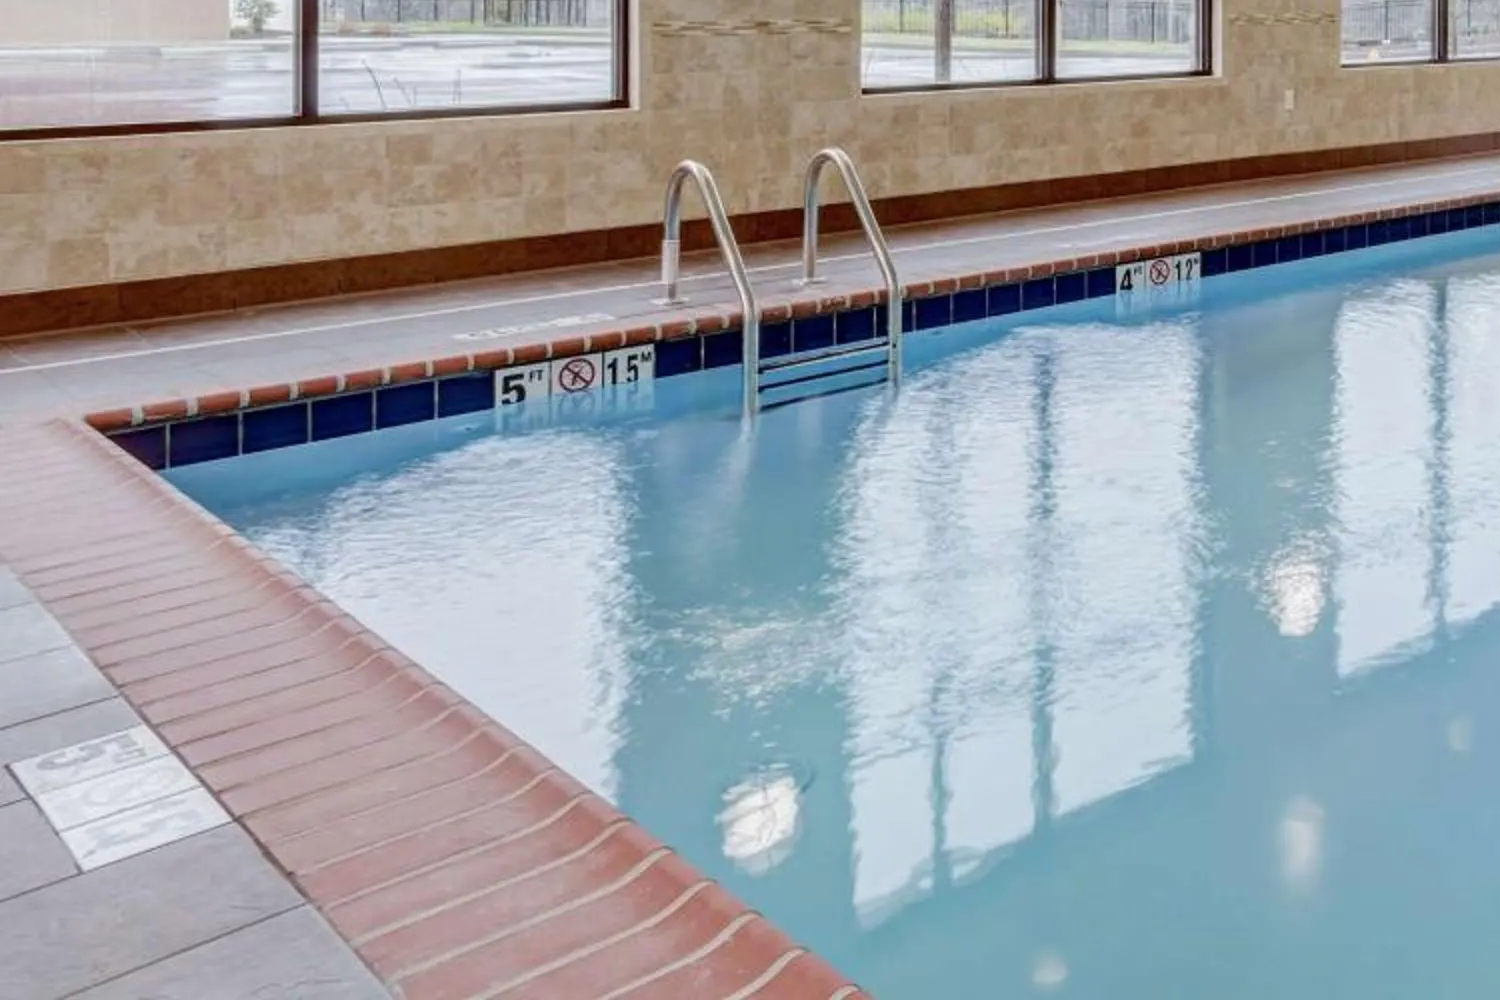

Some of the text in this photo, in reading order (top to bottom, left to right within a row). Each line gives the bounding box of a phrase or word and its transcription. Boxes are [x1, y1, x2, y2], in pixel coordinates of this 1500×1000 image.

[1120, 268, 1133, 291] 4
[501, 351, 652, 405] 5 FT 15 M
